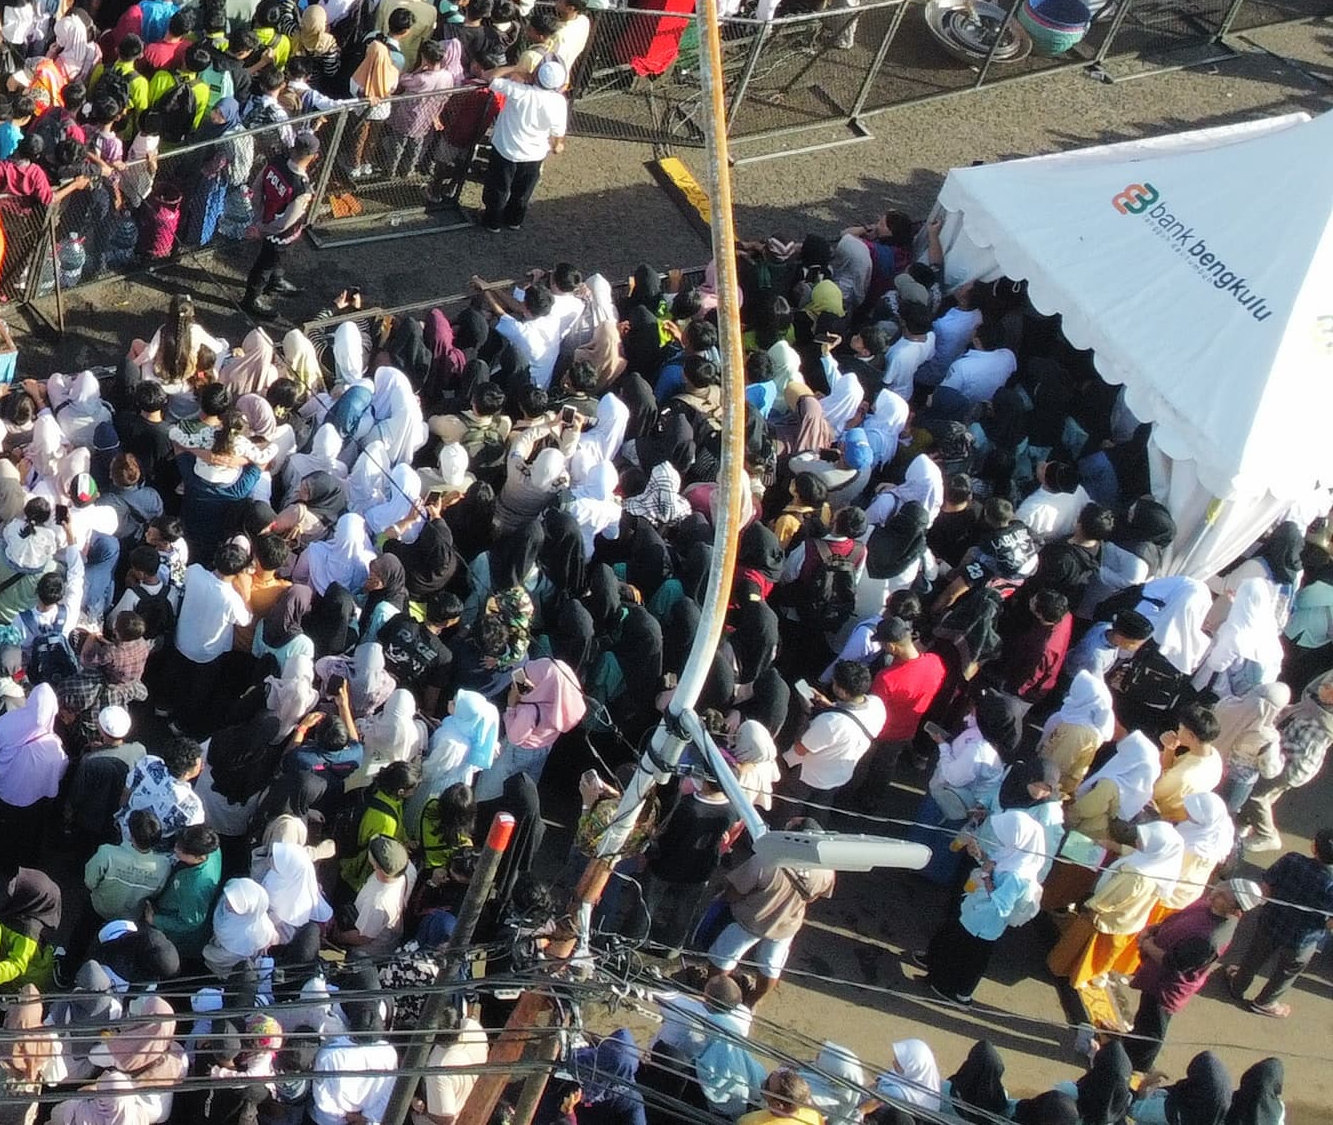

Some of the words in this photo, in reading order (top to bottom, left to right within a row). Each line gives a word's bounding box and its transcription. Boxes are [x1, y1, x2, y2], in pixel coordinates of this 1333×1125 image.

[266, 170, 287, 198] POLISI
[1148, 202, 1196, 246] bank
[1188, 239, 1274, 323] bengkulu
